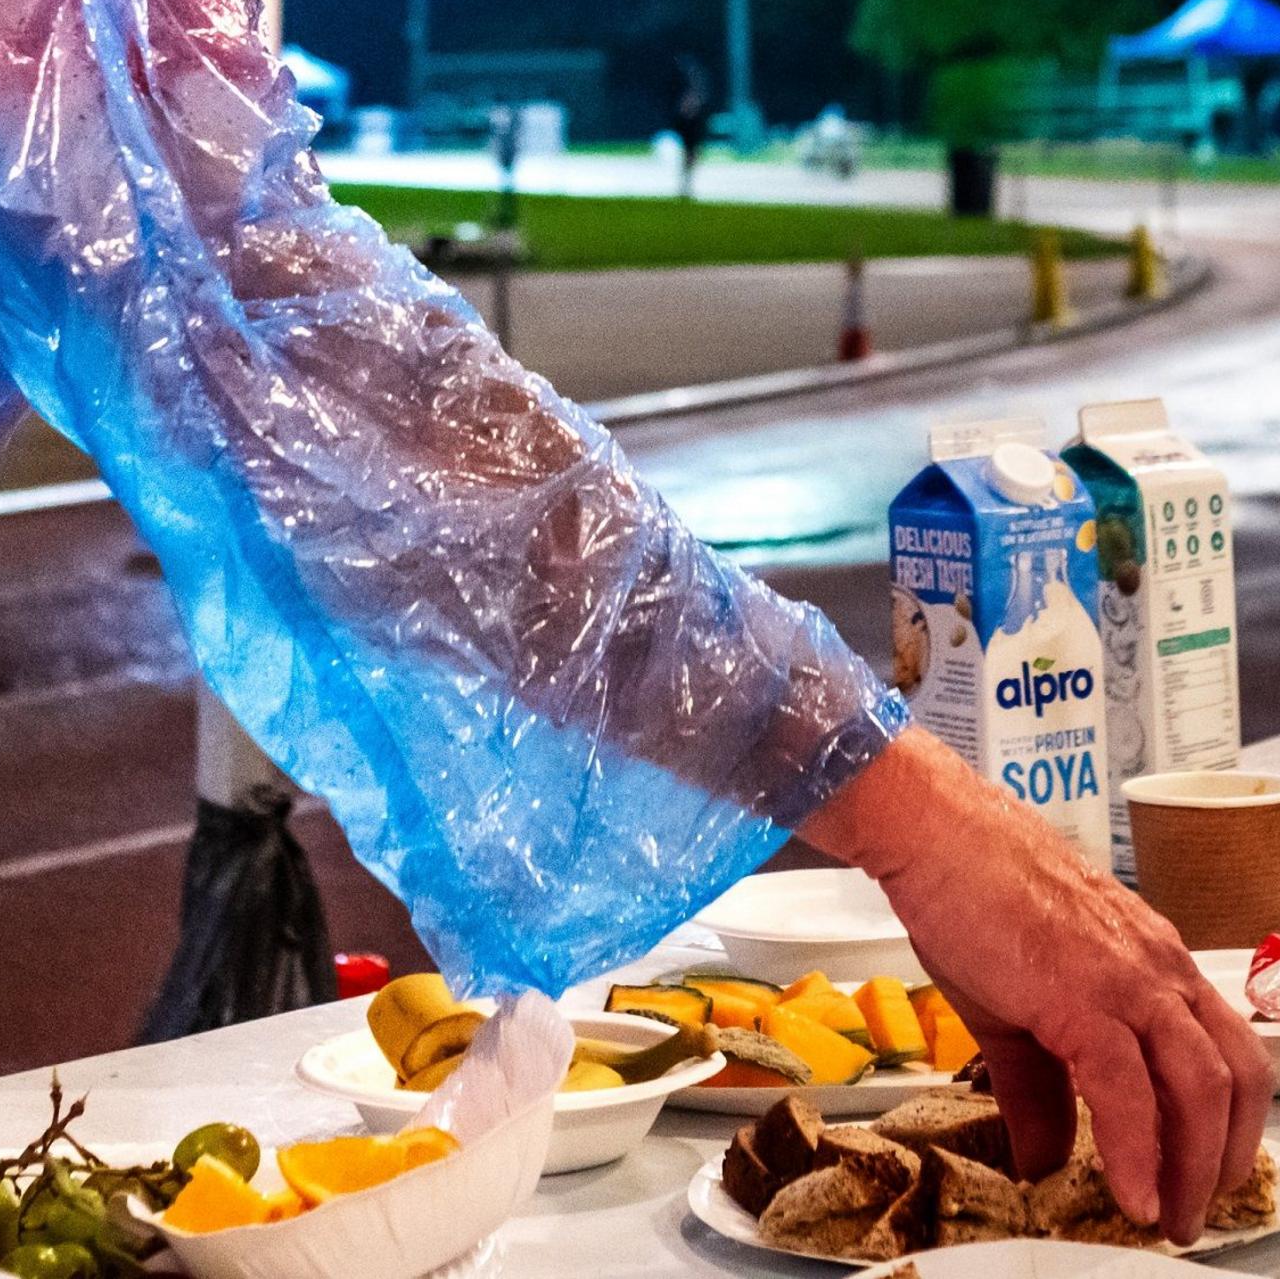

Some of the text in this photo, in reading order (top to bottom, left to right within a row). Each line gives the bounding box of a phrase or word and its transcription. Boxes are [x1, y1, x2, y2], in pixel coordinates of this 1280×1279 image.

[894, 525, 972, 558] DELICIOUS
[896, 555, 934, 590] FRESH
[996, 660, 1094, 718] alpro
[1035, 726, 1095, 753] PROTEIN
[1001, 751, 1099, 805] SOYA
